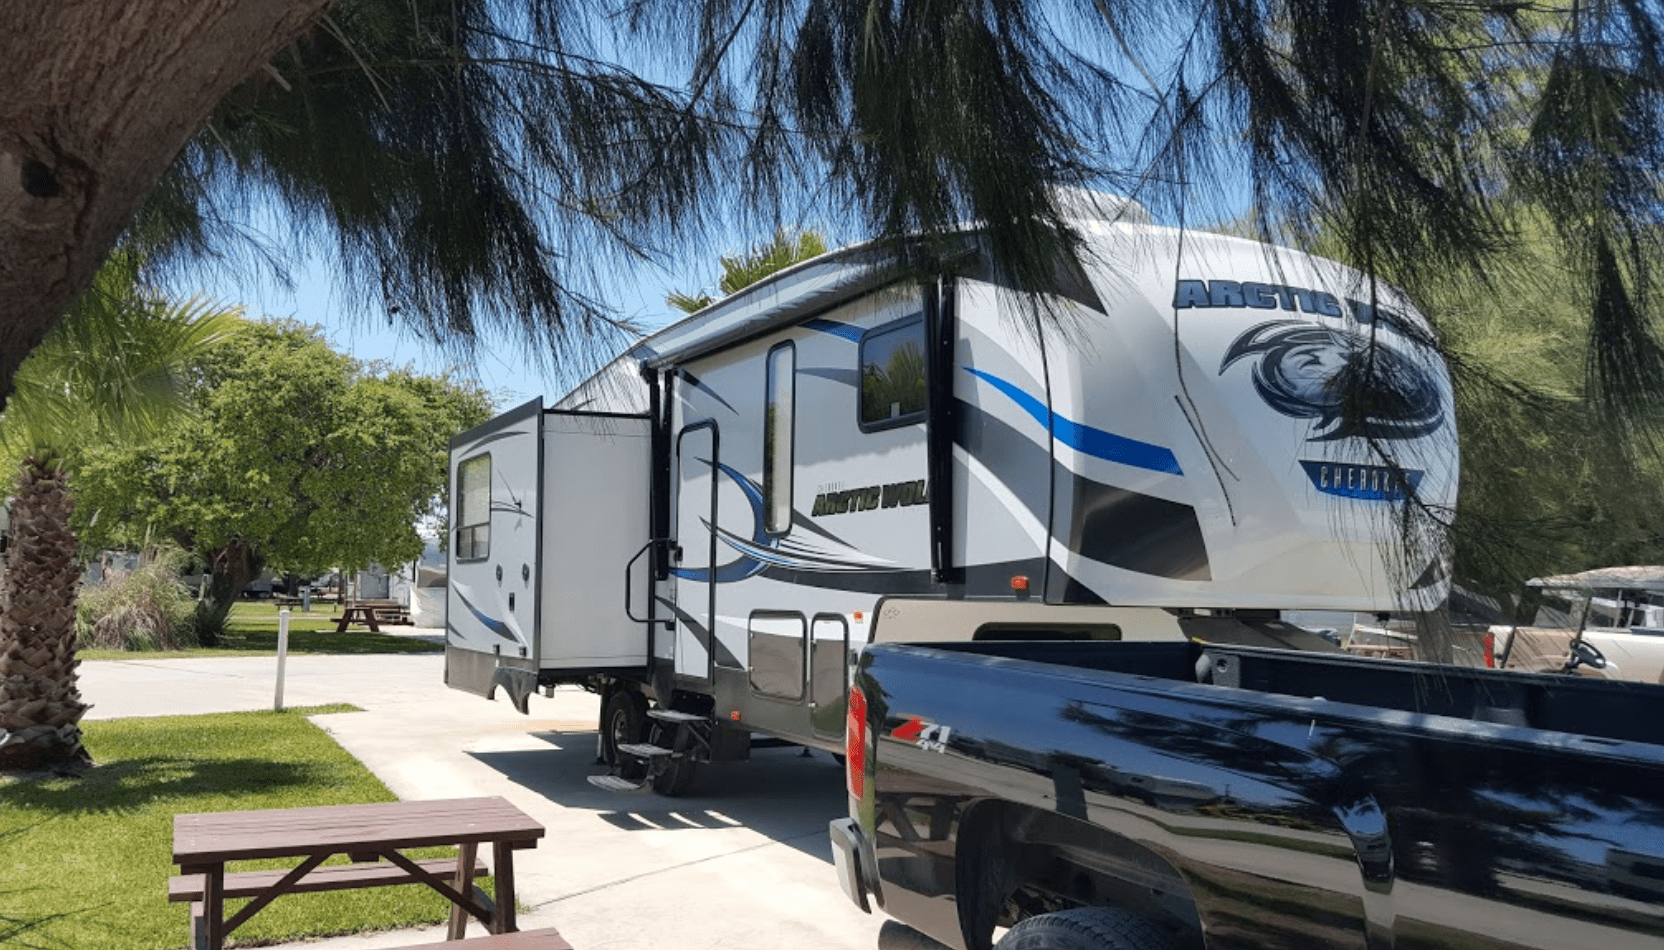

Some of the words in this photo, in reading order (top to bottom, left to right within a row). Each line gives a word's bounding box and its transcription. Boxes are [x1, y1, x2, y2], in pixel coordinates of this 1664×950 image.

[1174, 279, 1343, 317] ARCTIC
[811, 485, 882, 517] ARCTIC
[880, 479, 930, 509] WOL
[890, 715, 951, 743] Z71
